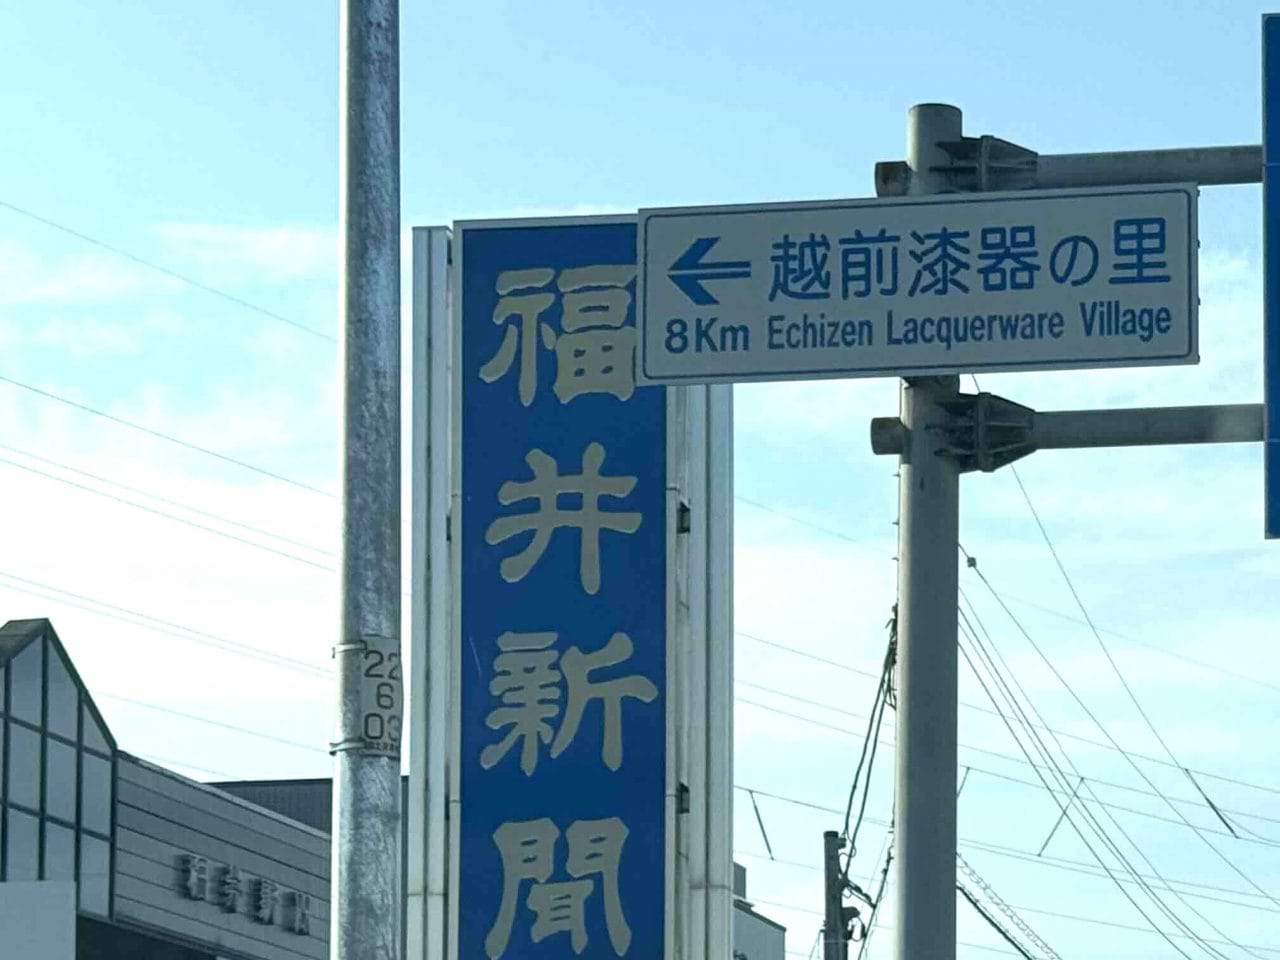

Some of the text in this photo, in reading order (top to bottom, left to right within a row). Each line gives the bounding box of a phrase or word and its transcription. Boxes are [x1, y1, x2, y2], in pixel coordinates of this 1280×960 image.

[768, 217, 1171, 301] 越前漆器の里
[767, 312, 873, 350] Echizen
[886, 304, 1065, 350] Lacquerware
[1080, 299, 1171, 342] Village
[376, 682, 395, 710] 6
